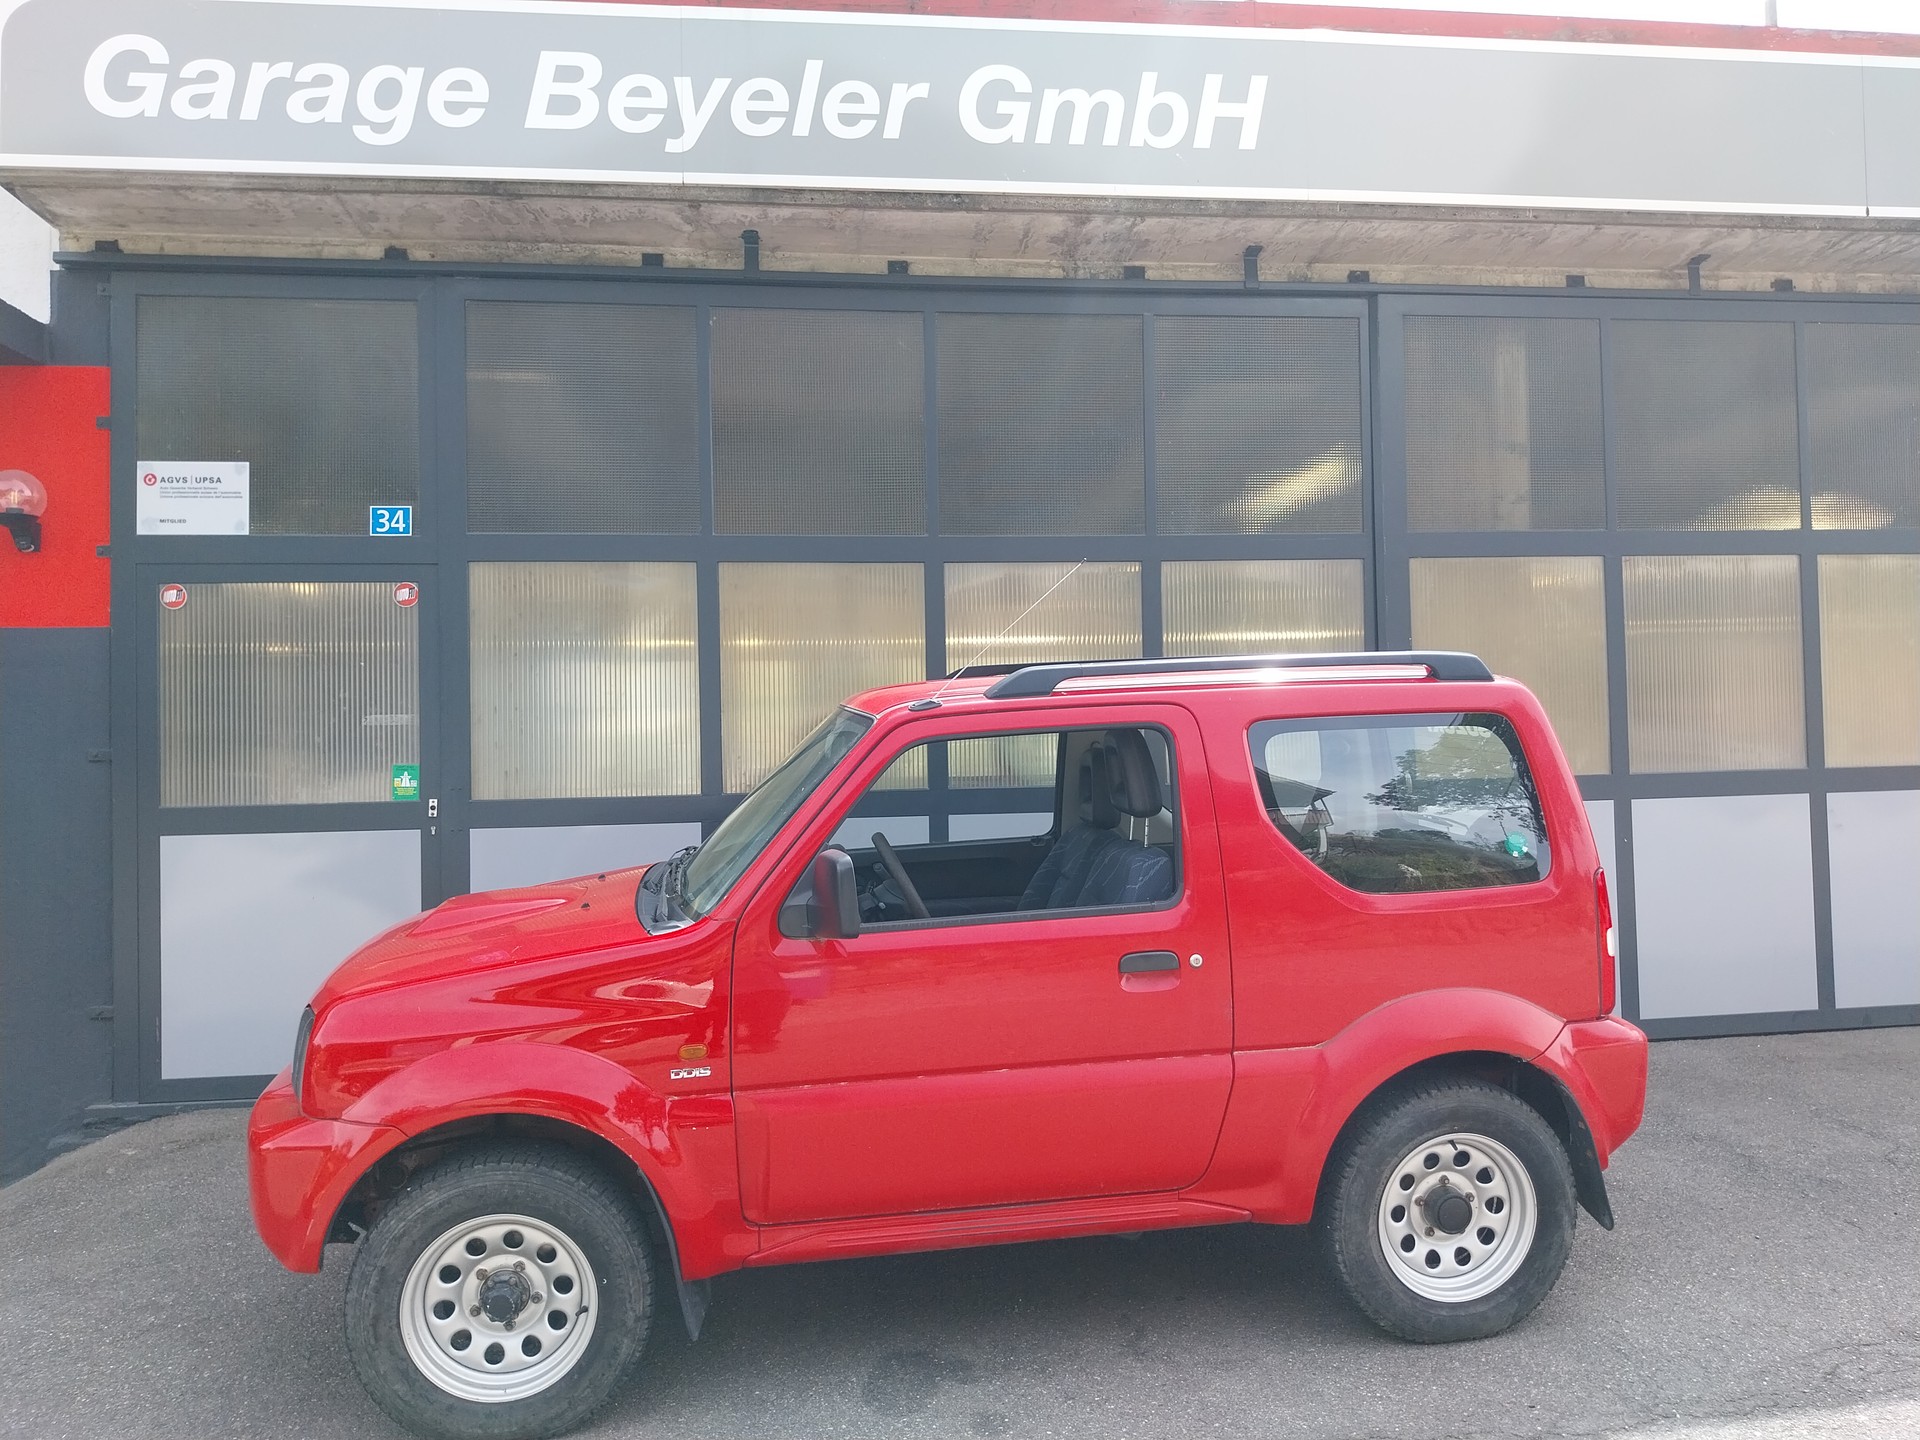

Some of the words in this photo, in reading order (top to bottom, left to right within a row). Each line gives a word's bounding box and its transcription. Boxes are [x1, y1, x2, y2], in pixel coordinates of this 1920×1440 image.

[84, 34, 490, 146] Garage
[523, 50, 930, 154] Beyeler
[957, 63, 1269, 150] GmbH
[159, 476, 188, 484] AGVS
[195, 476, 222, 484] UPSA
[376, 509, 406, 533] 34
